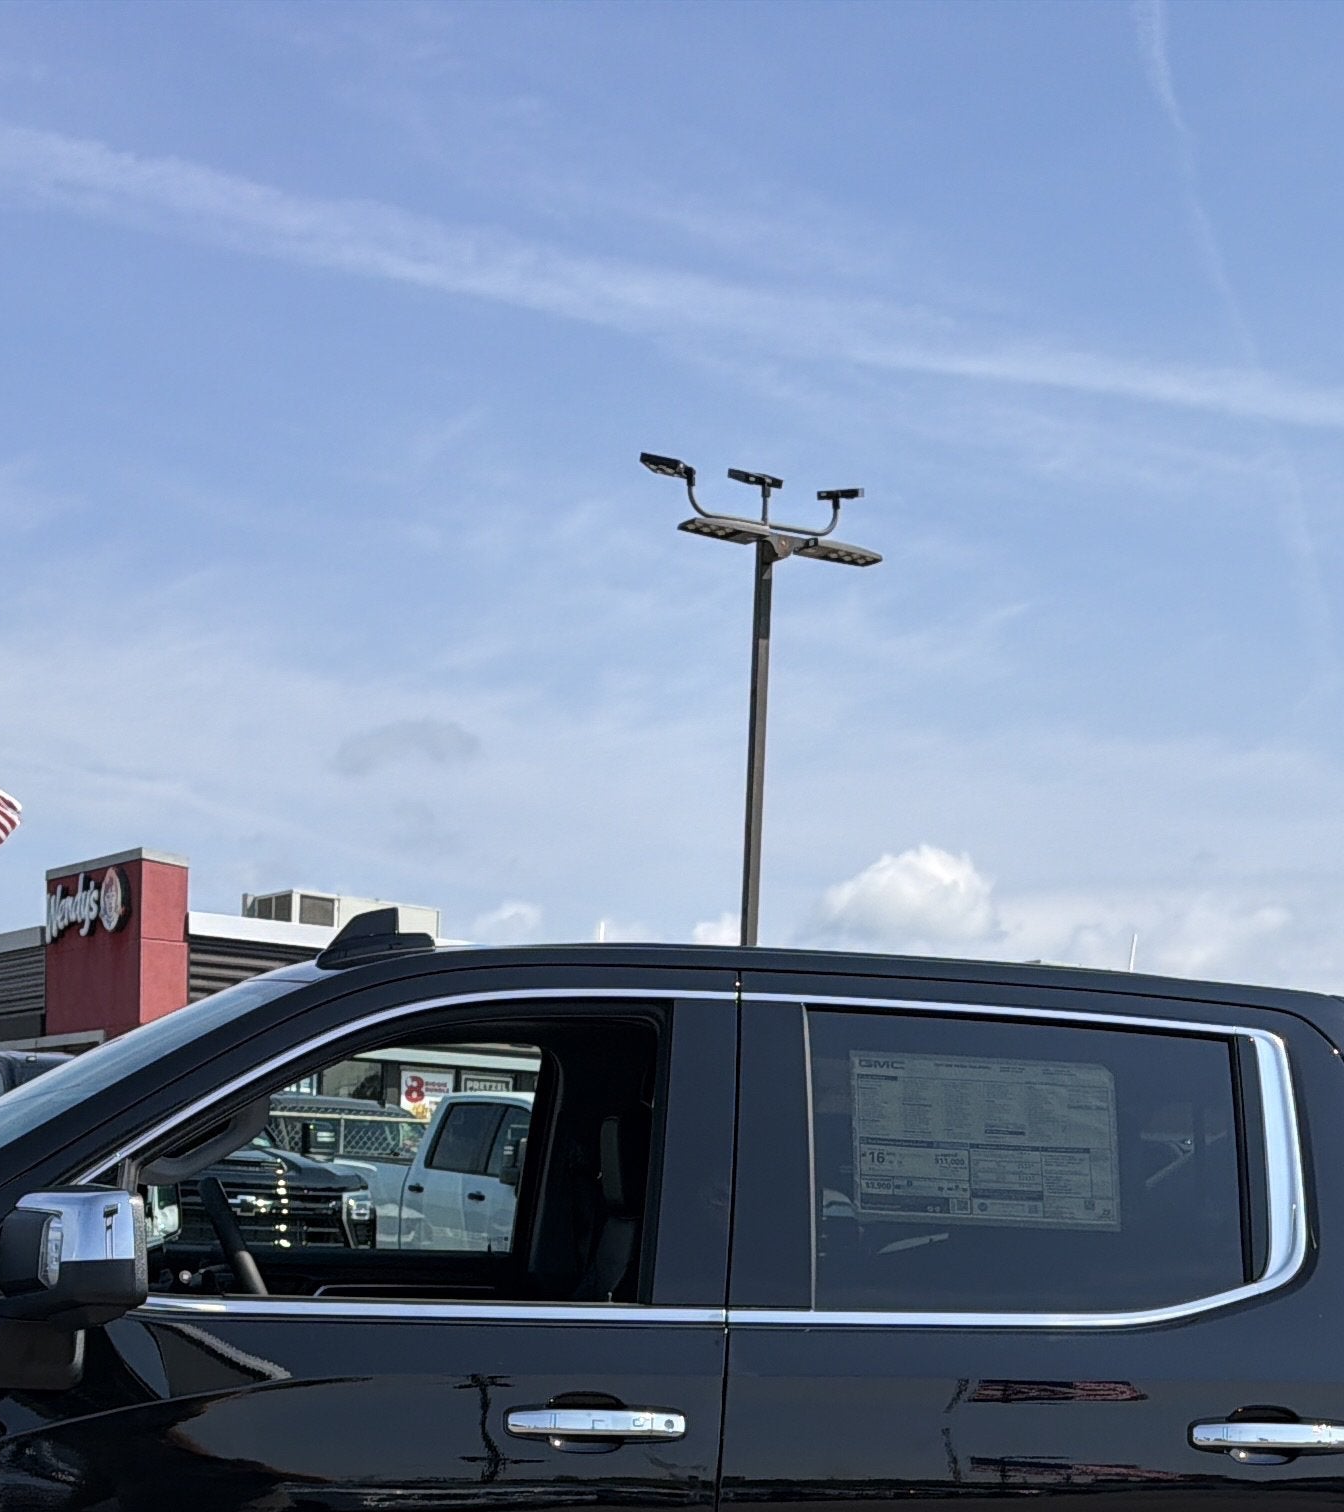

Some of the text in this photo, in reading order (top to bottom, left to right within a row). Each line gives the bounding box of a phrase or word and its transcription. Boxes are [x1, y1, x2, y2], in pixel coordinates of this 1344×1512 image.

[45, 872, 99, 944] Wendy's
[857, 1058, 906, 1071] GMC
[868, 1150, 886, 1165] 16
